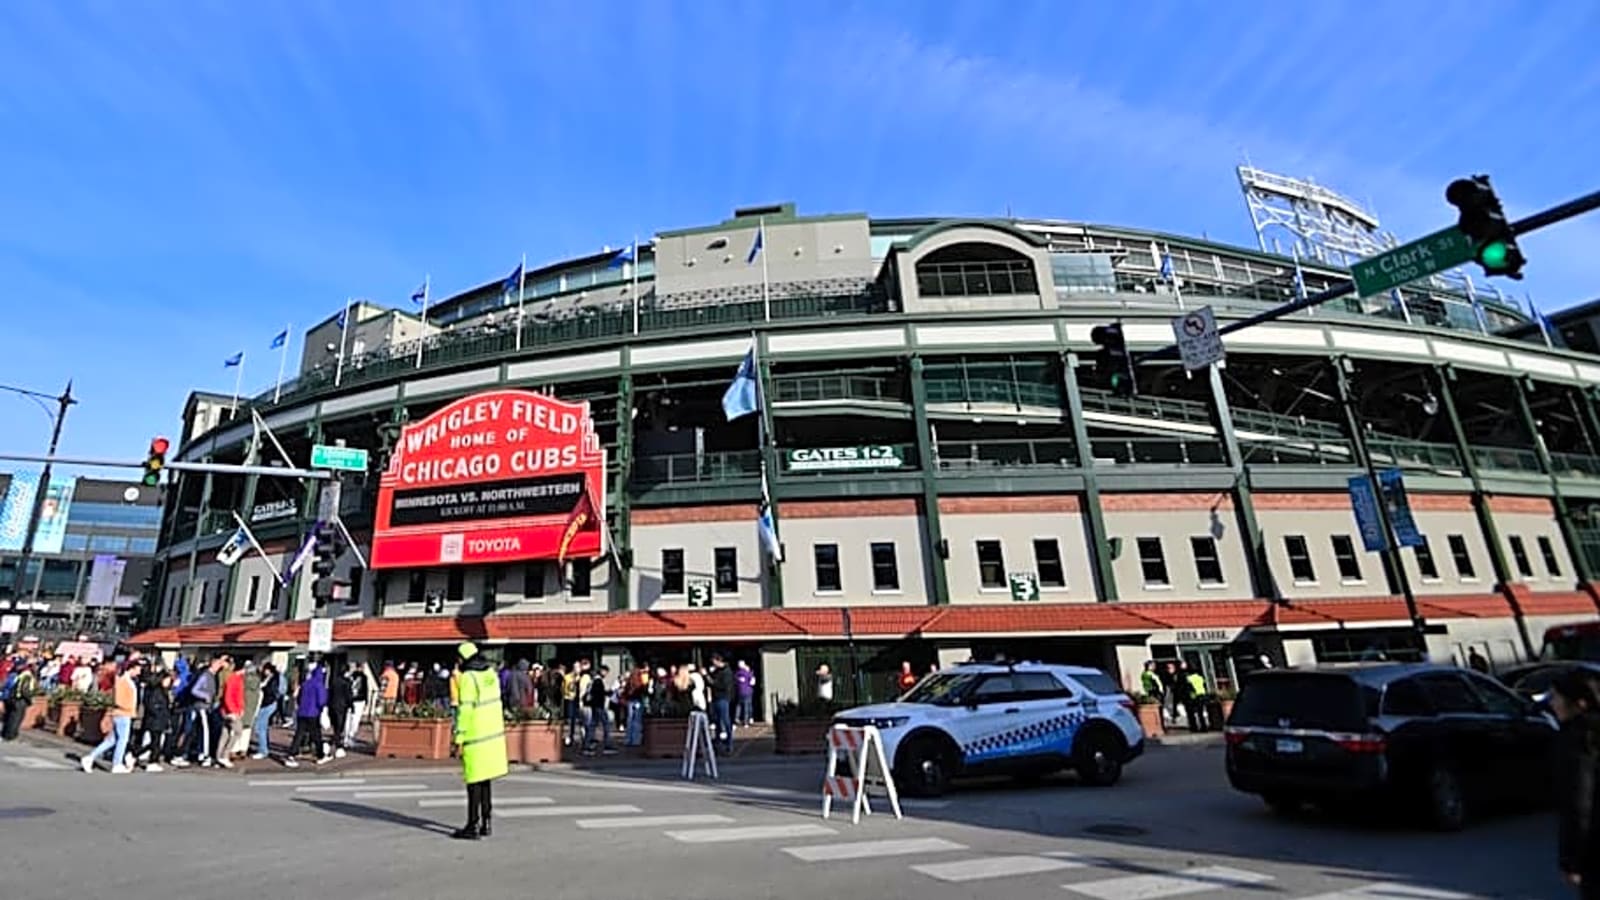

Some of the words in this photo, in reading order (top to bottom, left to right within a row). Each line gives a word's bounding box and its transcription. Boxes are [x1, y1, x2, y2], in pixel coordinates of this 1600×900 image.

[1379, 244, 1432, 273] Clark
[406, 398, 504, 453] WRIGLEY
[512, 399, 577, 434] FIELD
[450, 431, 496, 449] HOME
[506, 427, 529, 442] OF
[402, 453, 500, 483] CHICAGO
[510, 445, 577, 472] CUBS
[792, 447, 858, 461] GATES
[394, 493, 458, 509] MINNESOTA
[481, 482, 581, 500] NORTHWESTERN
[468, 536, 521, 554] TOYOTA
